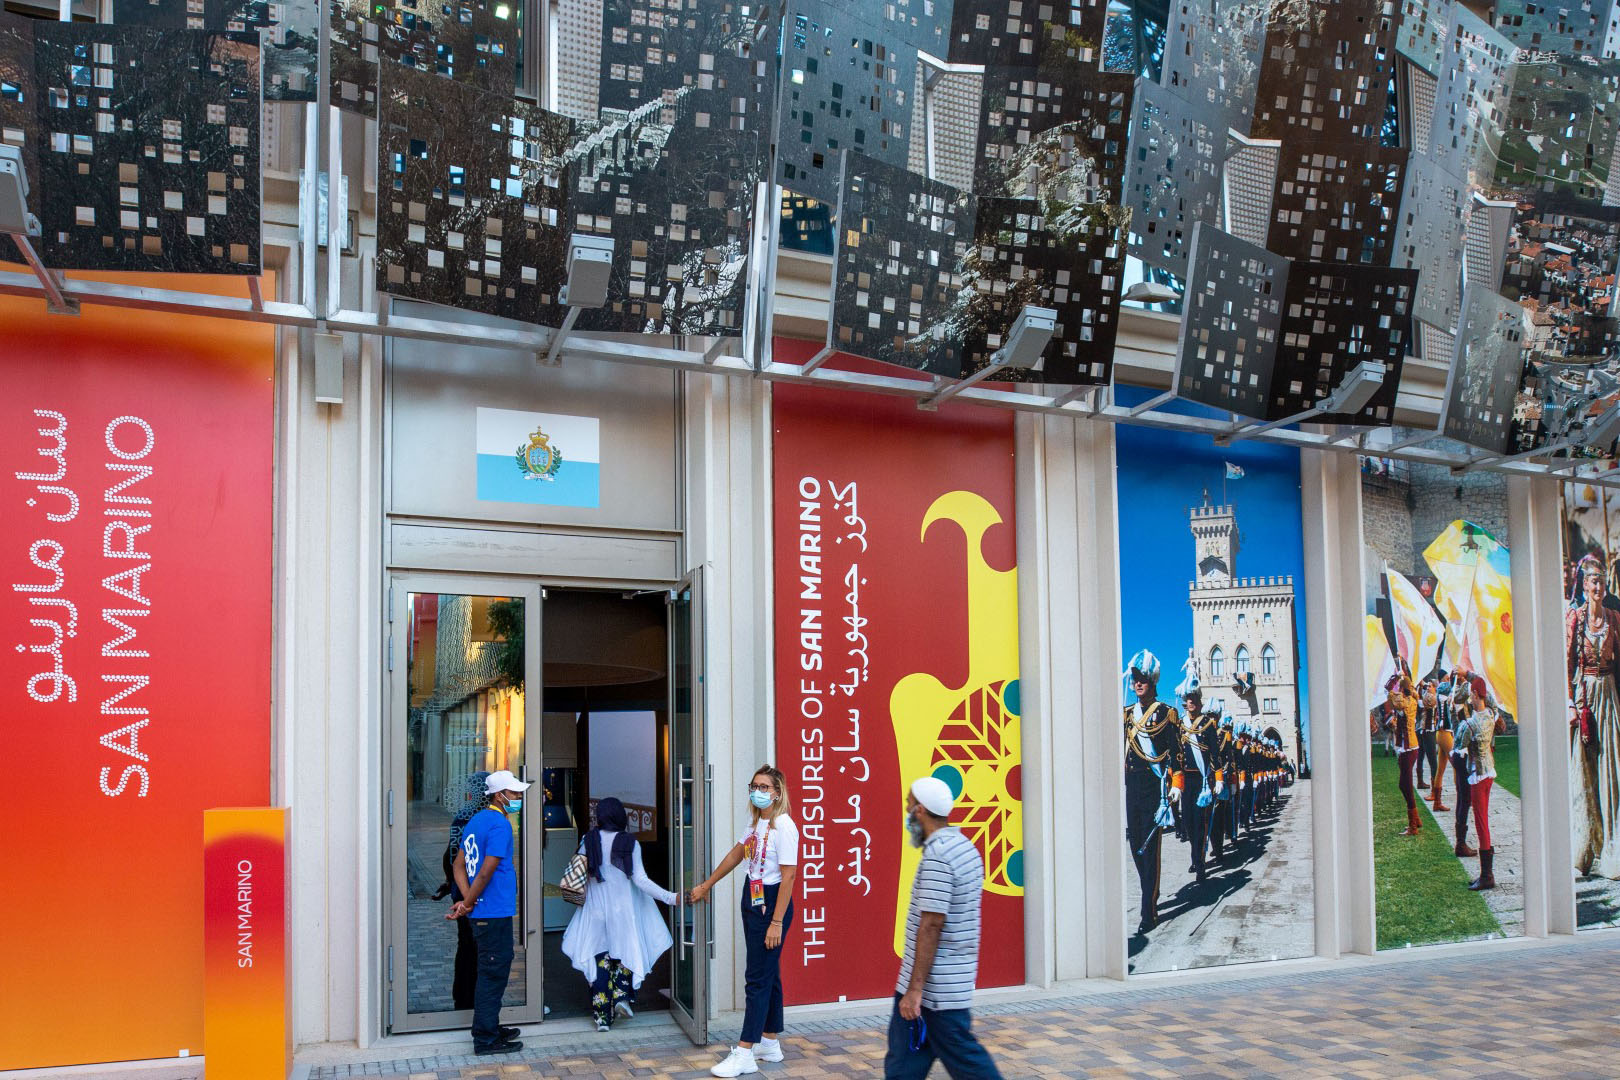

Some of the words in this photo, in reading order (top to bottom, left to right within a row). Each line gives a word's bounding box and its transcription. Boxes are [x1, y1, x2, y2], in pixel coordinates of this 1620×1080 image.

[15, 408, 80, 522] سان
[101, 415, 155, 658] MARINO
[799, 476, 823, 600] MARINO
[828, 479, 869, 554] كنوز
[12, 539, 79, 703] مارينو
[800, 608, 823, 671] SAN
[829, 562, 869, 697] جمهورية
[100, 673, 150, 798] SAN
[800, 678, 823, 719] OF
[445, 744, 493, 753] Entrance
[830, 708, 870, 783] سان
[801, 728, 825, 900] TREASURES
[831, 793, 872, 897] مارينو
[237, 859, 253, 930] MARINO
[803, 906, 826, 967] THE
[237, 932, 253, 969] SAN
